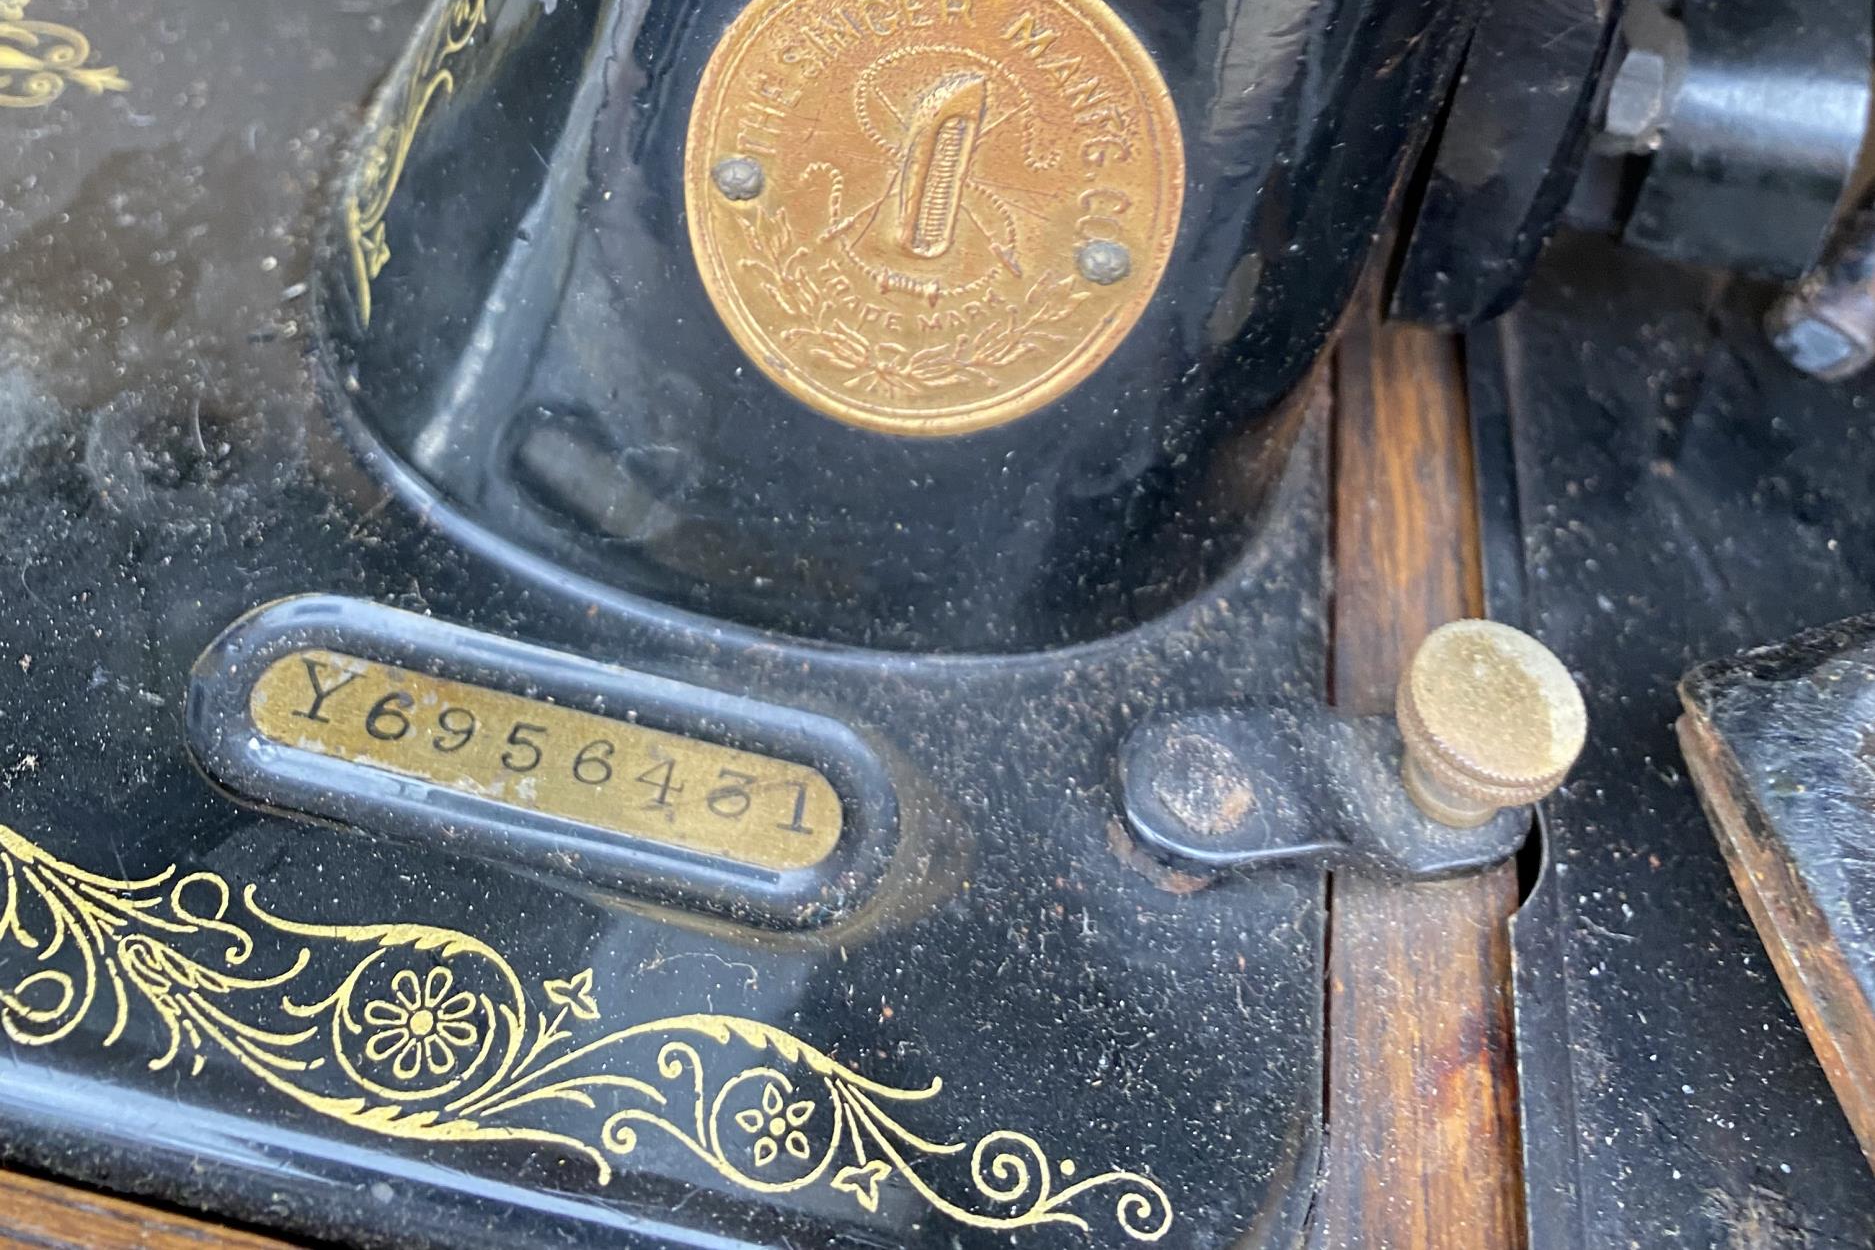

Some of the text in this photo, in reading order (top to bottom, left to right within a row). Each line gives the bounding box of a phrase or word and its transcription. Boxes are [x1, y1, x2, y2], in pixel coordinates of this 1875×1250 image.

[737, 73, 802, 155] THE
[818, 258, 1006, 332] TRADE MARK
